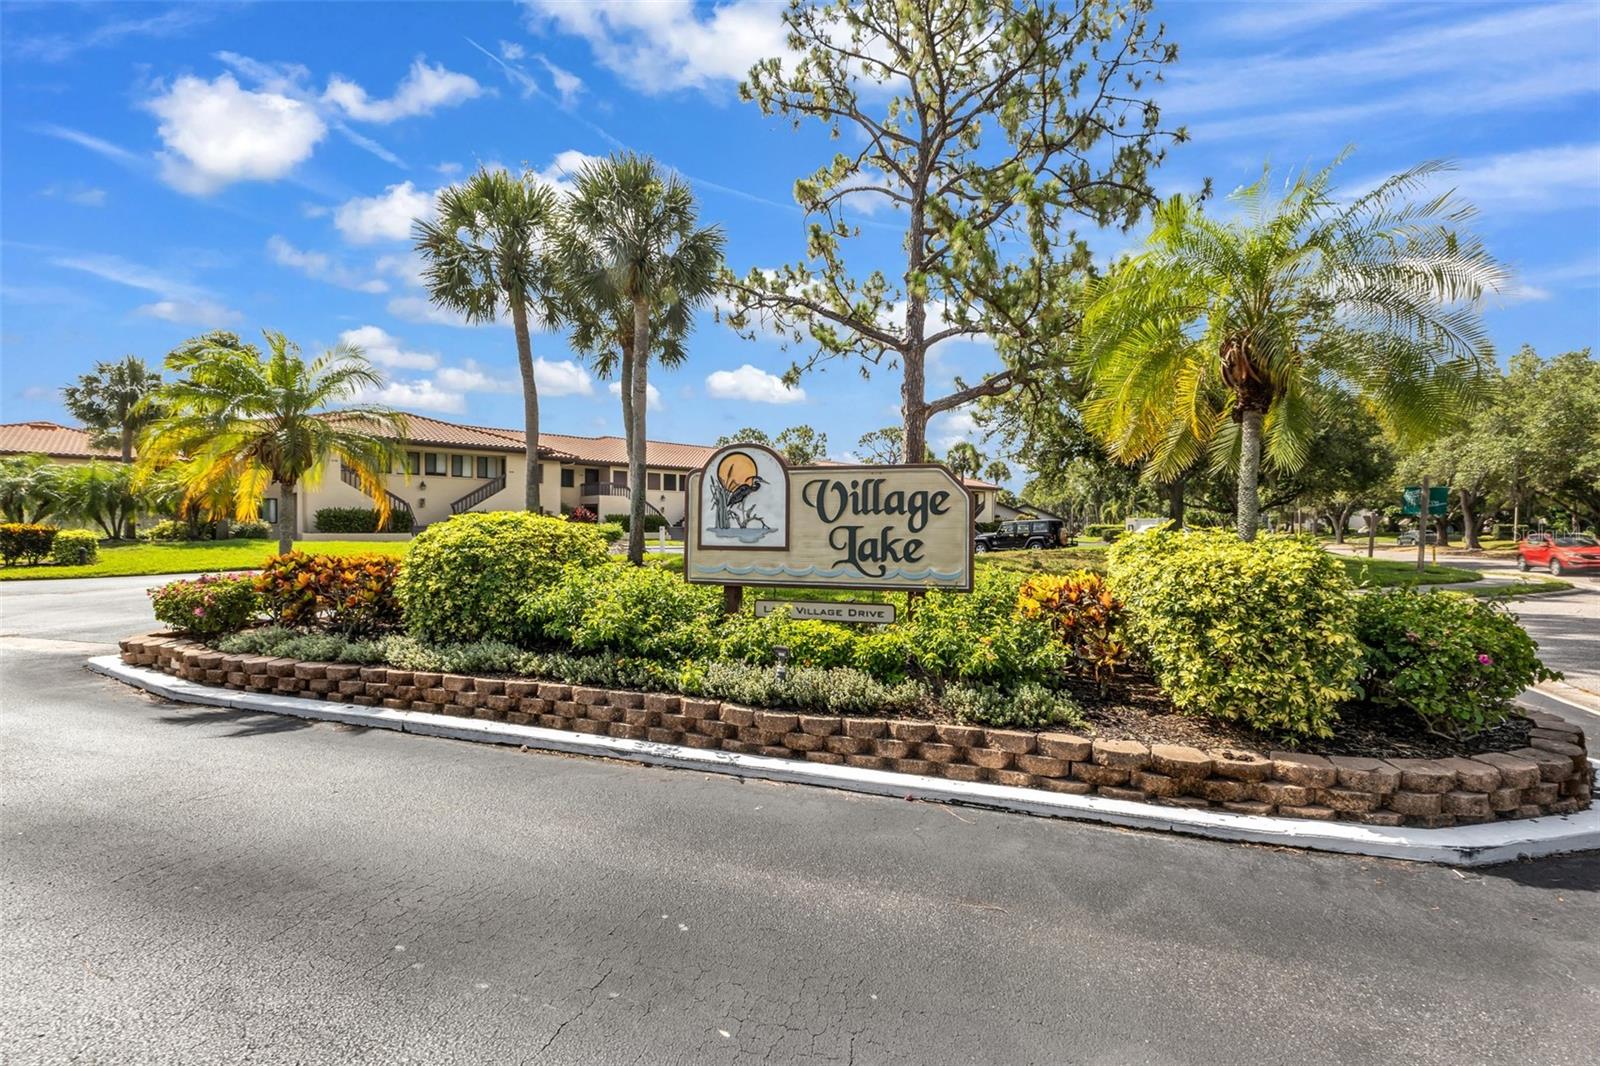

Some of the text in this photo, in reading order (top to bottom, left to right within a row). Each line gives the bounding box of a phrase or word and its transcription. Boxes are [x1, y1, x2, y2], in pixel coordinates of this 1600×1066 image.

[802, 478, 951, 533] Village
[829, 525, 924, 578] Lake
[848, 608, 885, 618] DRIVE
